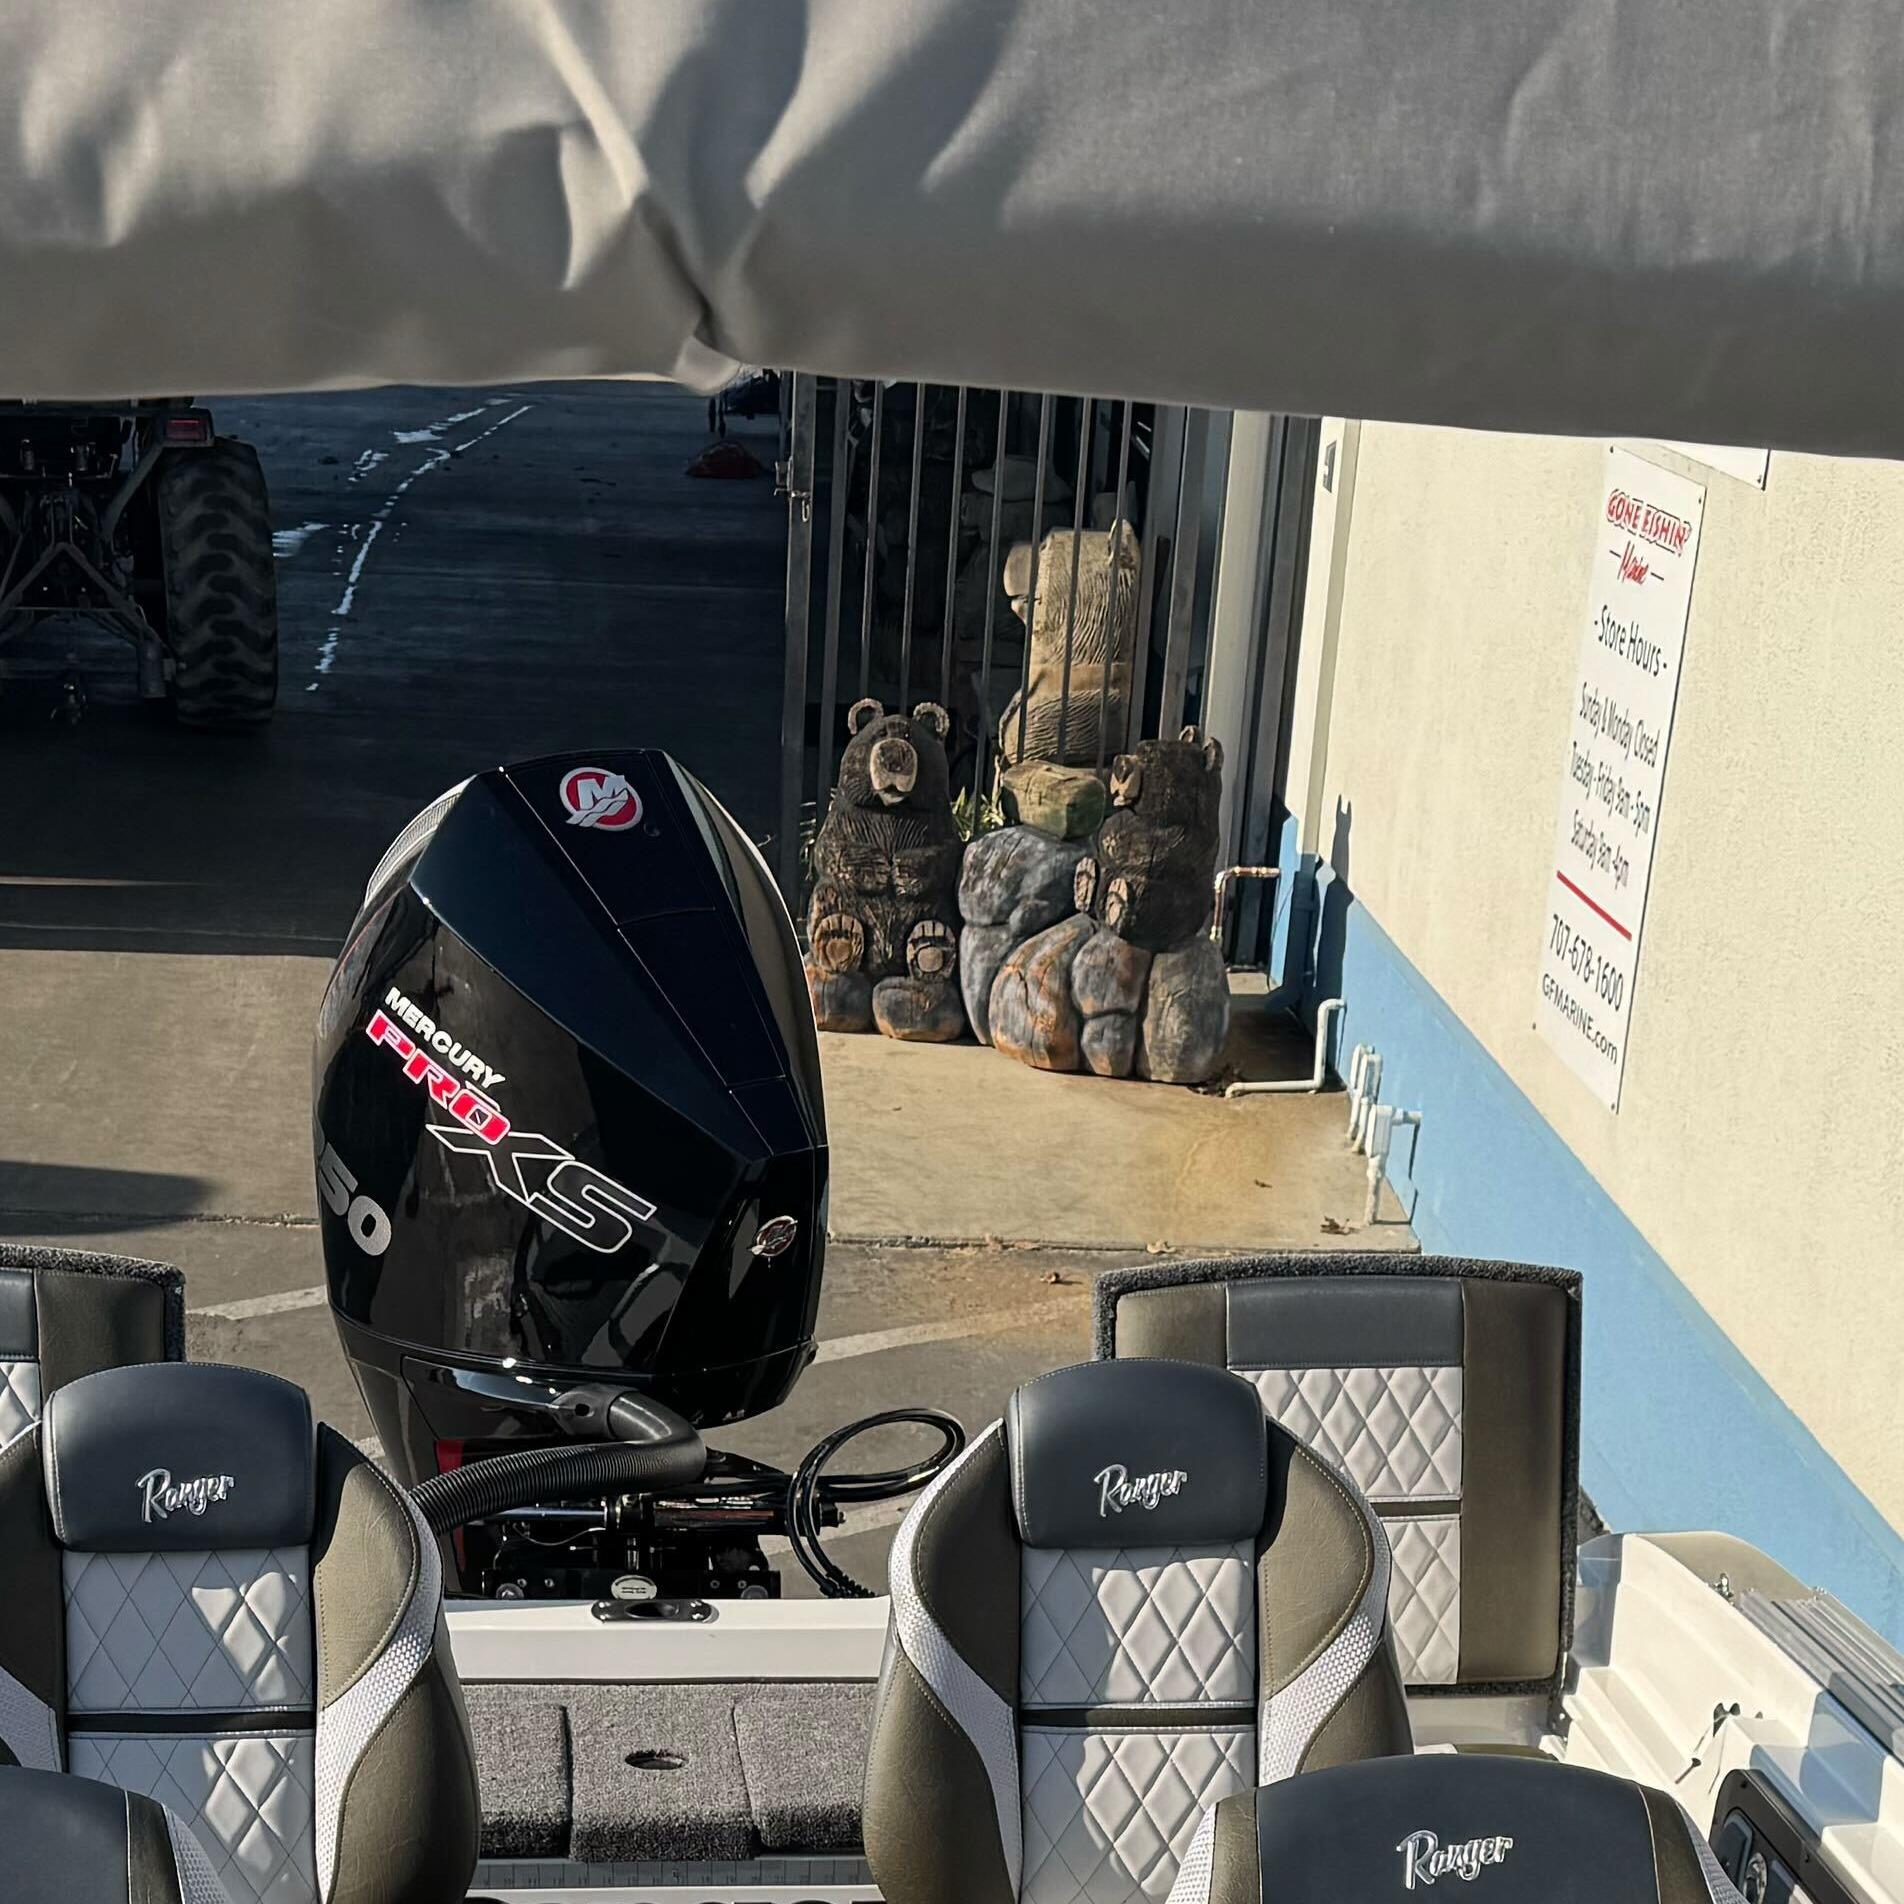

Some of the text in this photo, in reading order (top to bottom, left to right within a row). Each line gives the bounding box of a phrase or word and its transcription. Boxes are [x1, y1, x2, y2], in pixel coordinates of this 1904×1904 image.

[1598, 604, 1661, 677] Store Hours
[1579, 682, 1601, 738] Sunday
[1608, 701, 1632, 760] Monday
[1634, 719, 1660, 768] Closed
[1573, 740, 1593, 800] Tuesday
[1596, 761, 1614, 817] Friday
[1571, 809, 1596, 870] Saturday
[1550, 913, 1623, 1012] 707-678-1600
[384, 986, 507, 1089] MERCURY
[1542, 973, 1617, 1064] GFMARINE.com
[425, 1123, 658, 1253] XS
[137, 1467, 235, 1522] Ranger
[1094, 1463, 1188, 1518] Ranger
[1396, 1829, 1513, 1889] Ranger
